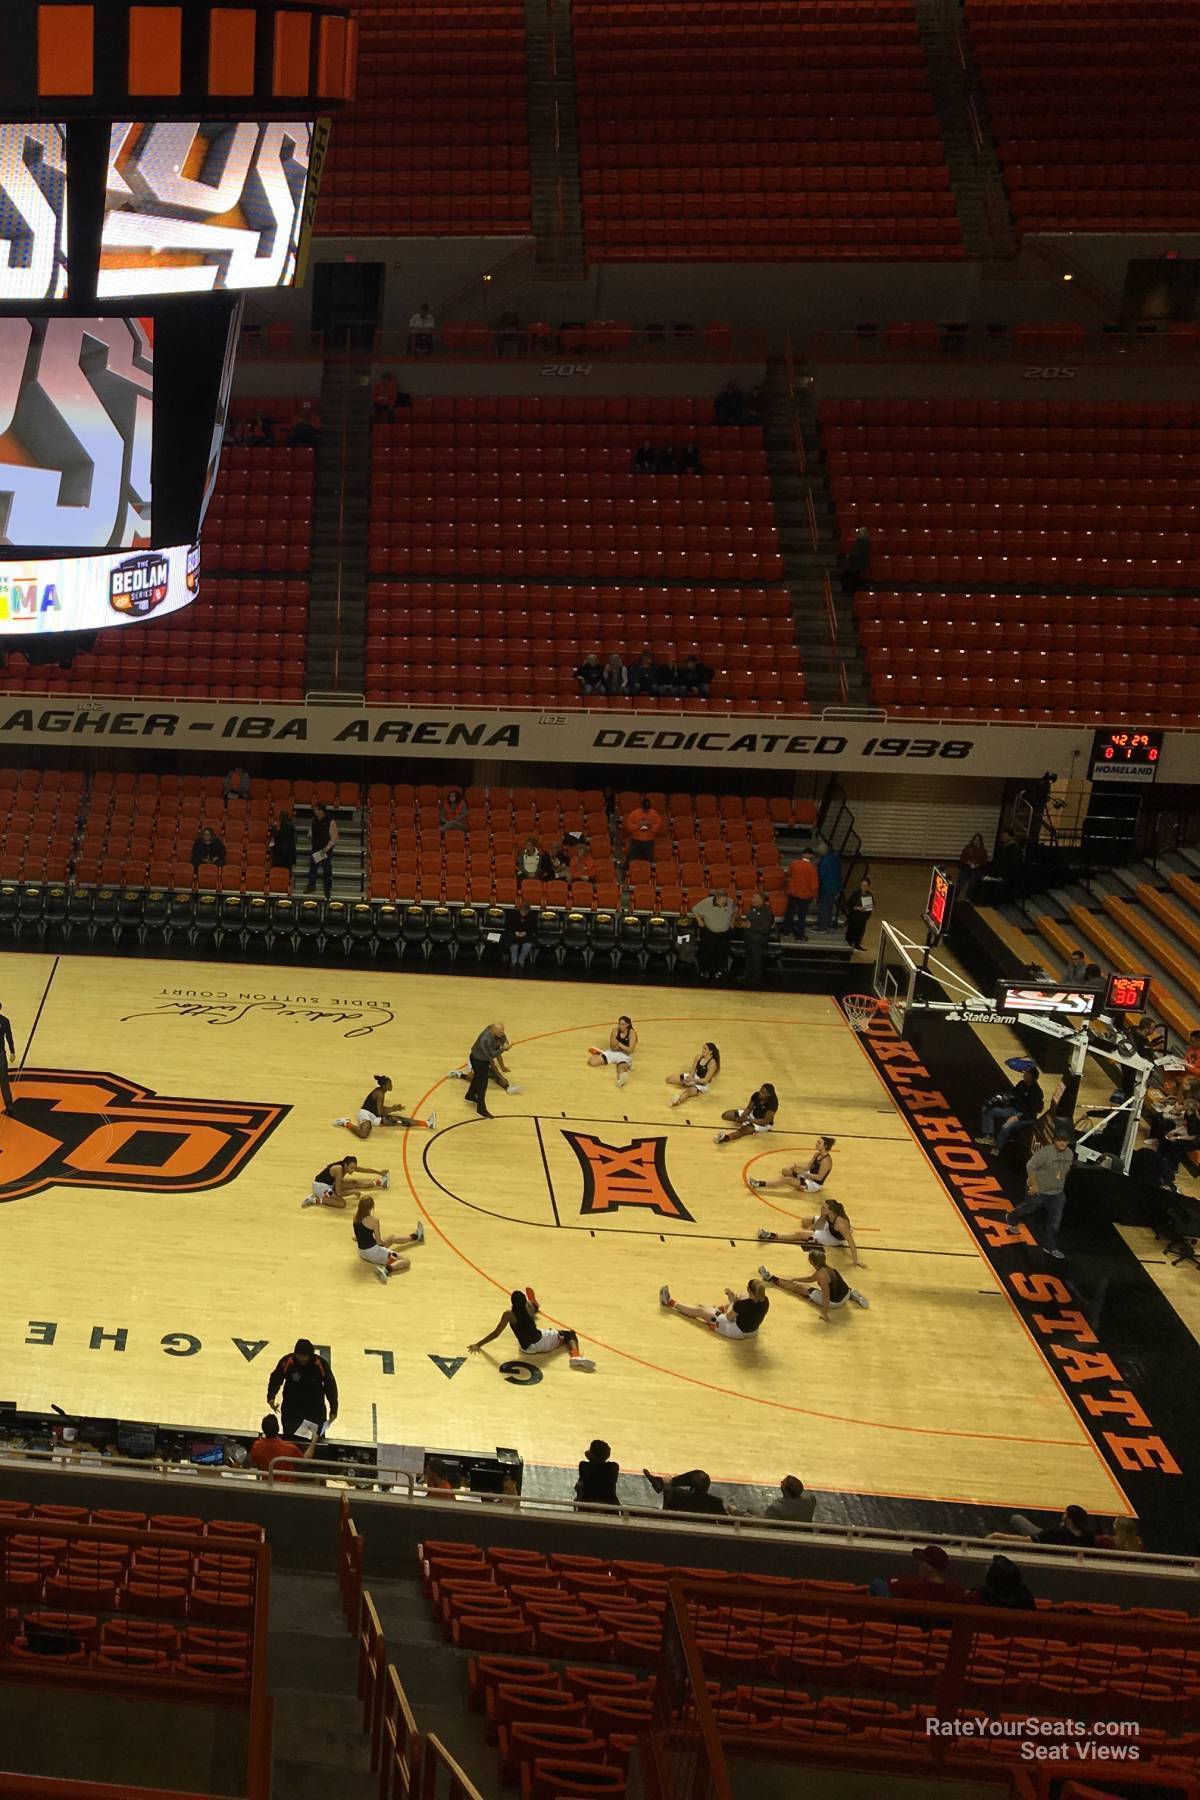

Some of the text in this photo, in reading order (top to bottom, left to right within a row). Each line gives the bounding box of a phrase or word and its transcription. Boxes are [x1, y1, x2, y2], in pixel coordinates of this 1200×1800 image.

[112, 563, 167, 594] BEDLAM
[334, 720, 521, 747] ARENA
[593, 729, 974, 759] DEDICATED 1938
[1008, 1272, 1183, 1475] STATE
